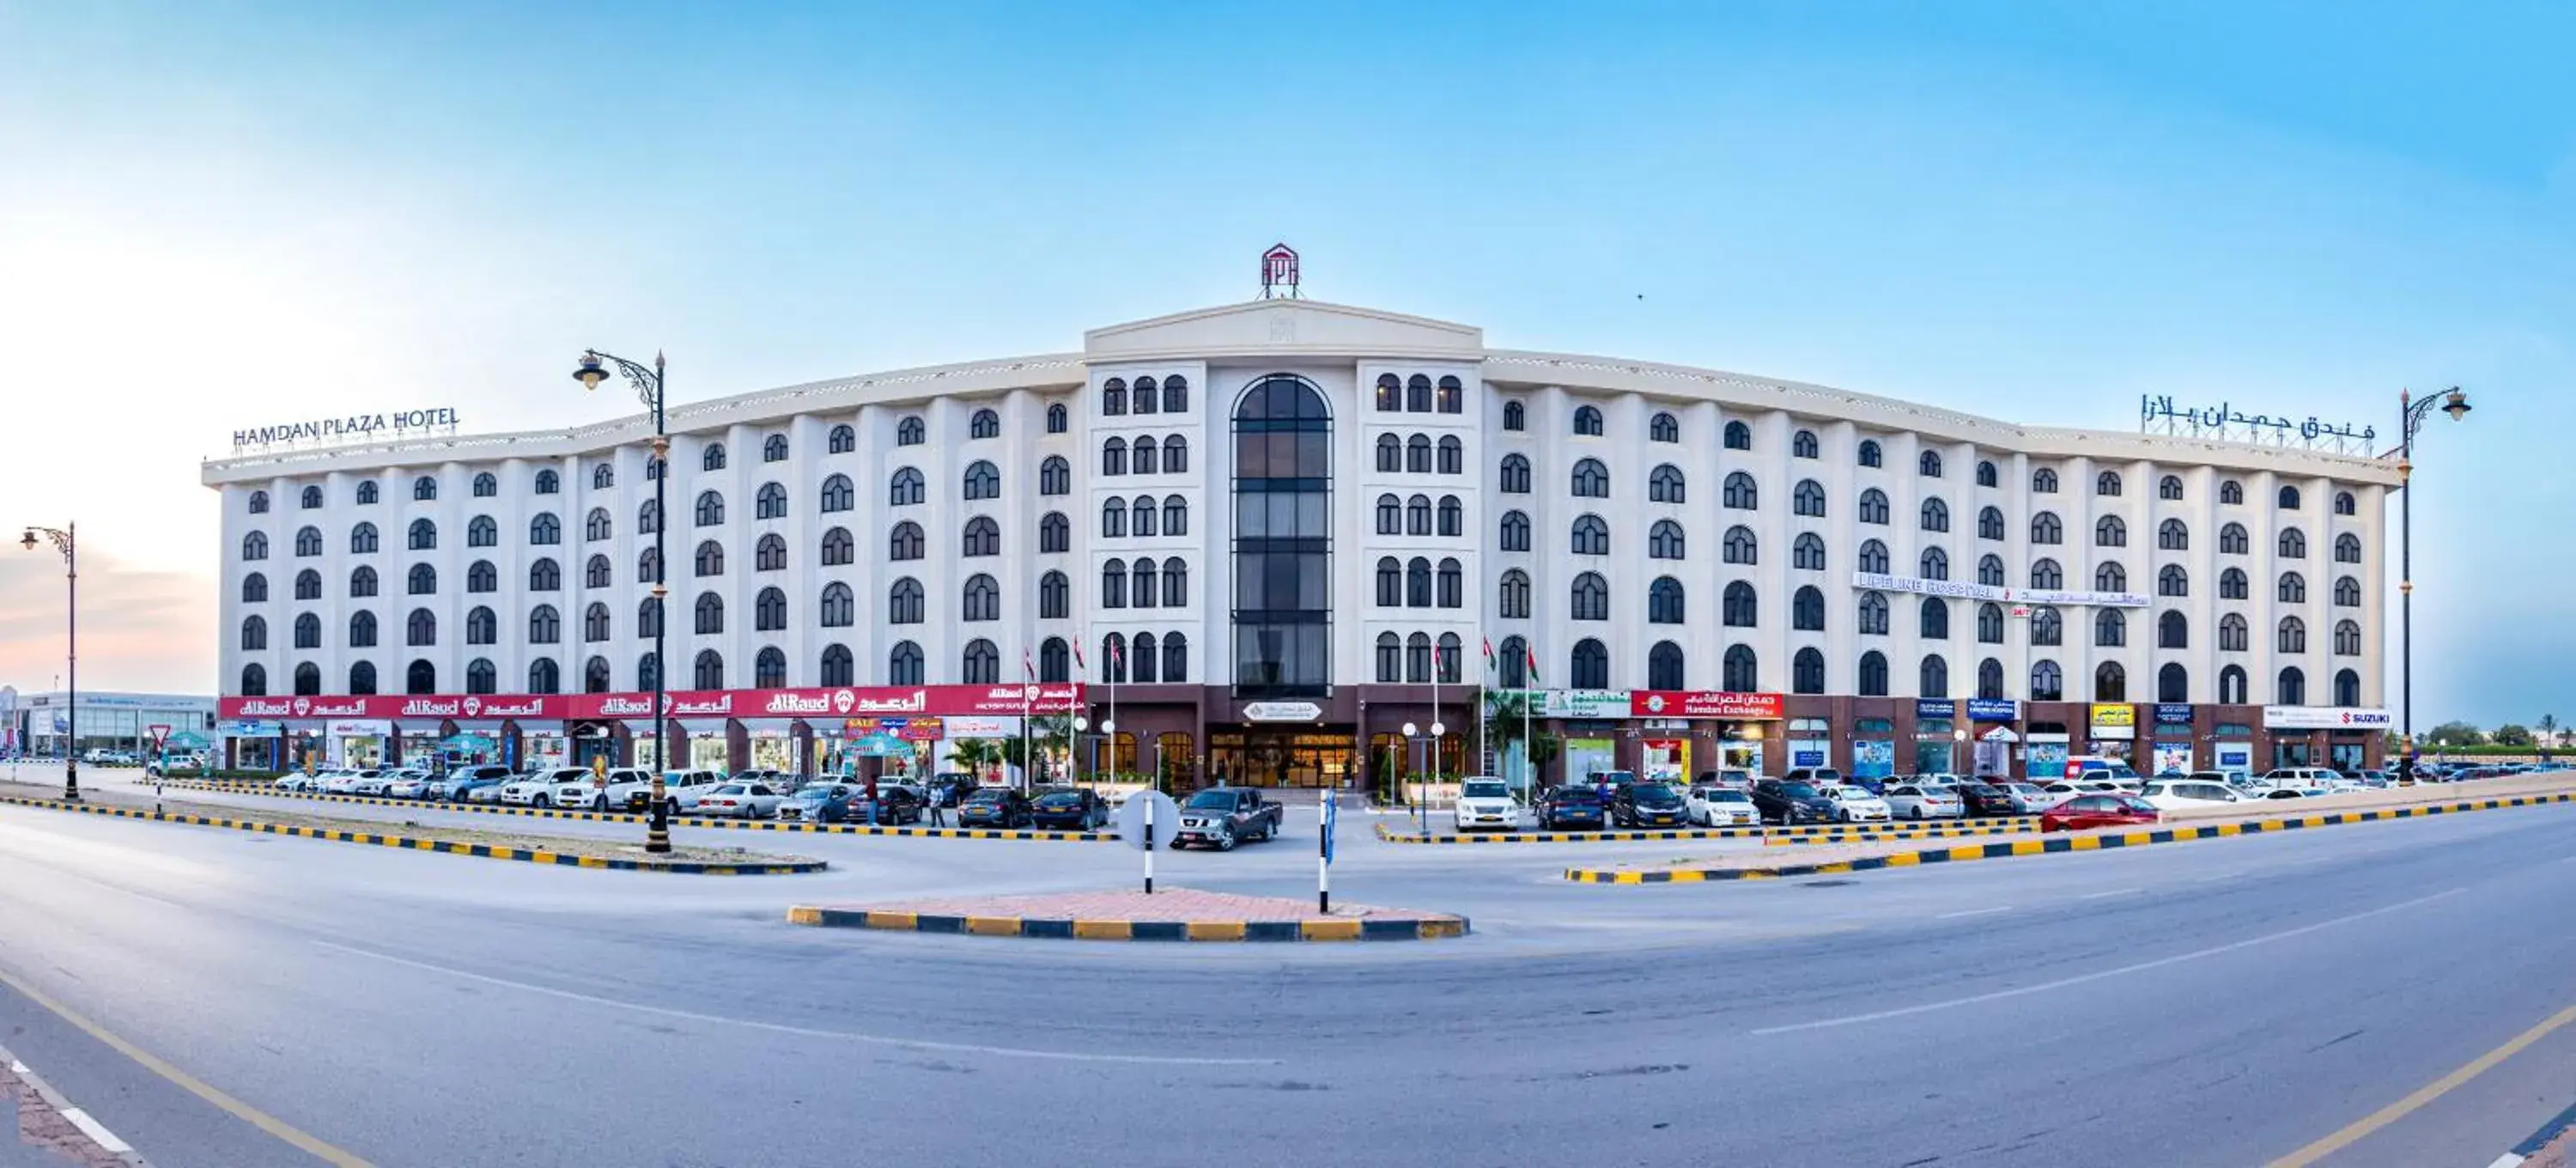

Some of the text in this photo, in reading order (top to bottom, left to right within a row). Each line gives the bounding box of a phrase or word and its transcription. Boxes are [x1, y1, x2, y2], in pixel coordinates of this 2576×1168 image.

[2203, 402, 2292, 428] حمدان
[234, 408, 460, 445] HAMDAN PLAZA HOTEL
[2301, 417, 2375, 439] فندق
[766, 694, 829, 713] AlRaud
[1686, 705, 1721, 714] Hamdan
[2353, 714, 2390, 724] SUZUKI
